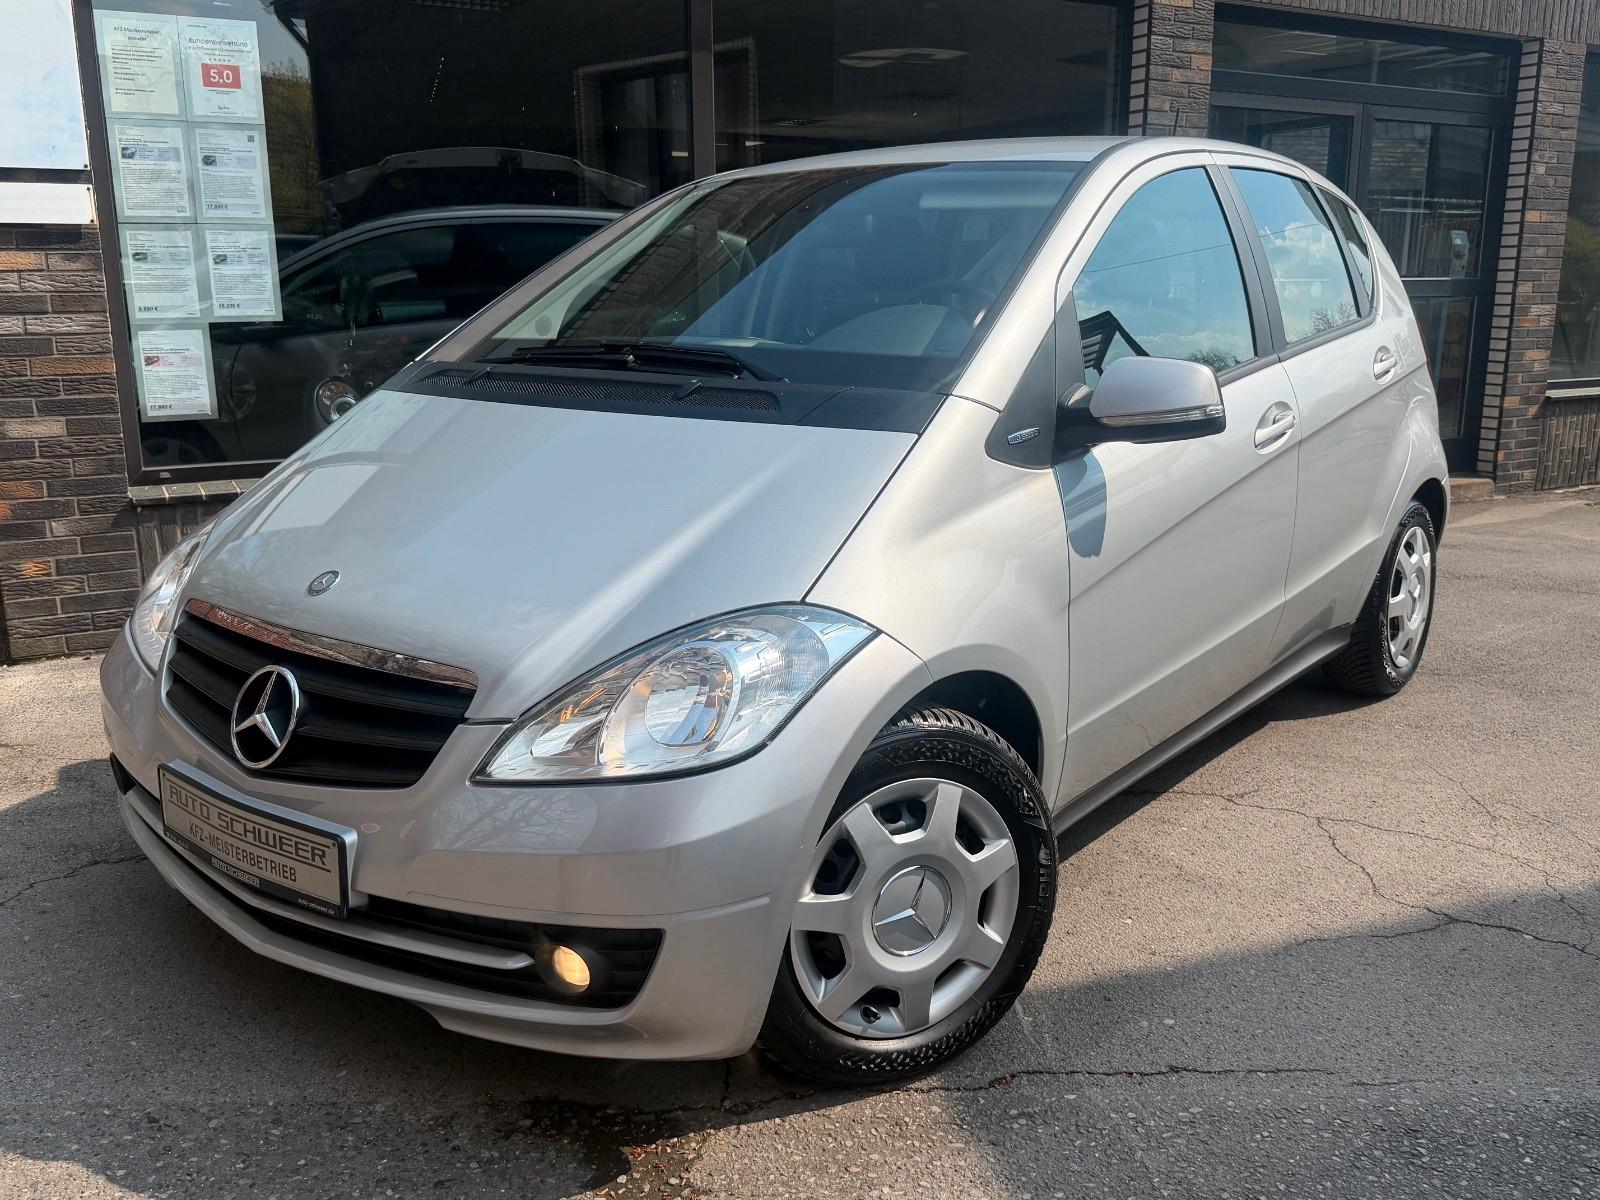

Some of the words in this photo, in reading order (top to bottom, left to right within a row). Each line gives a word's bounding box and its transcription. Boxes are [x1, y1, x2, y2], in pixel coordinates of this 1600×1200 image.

[169, 784, 210, 821] AUTO
[217, 813, 326, 866] SCHWEER
[189, 821, 297, 882] KFZ-MEISTERBETRIEB
